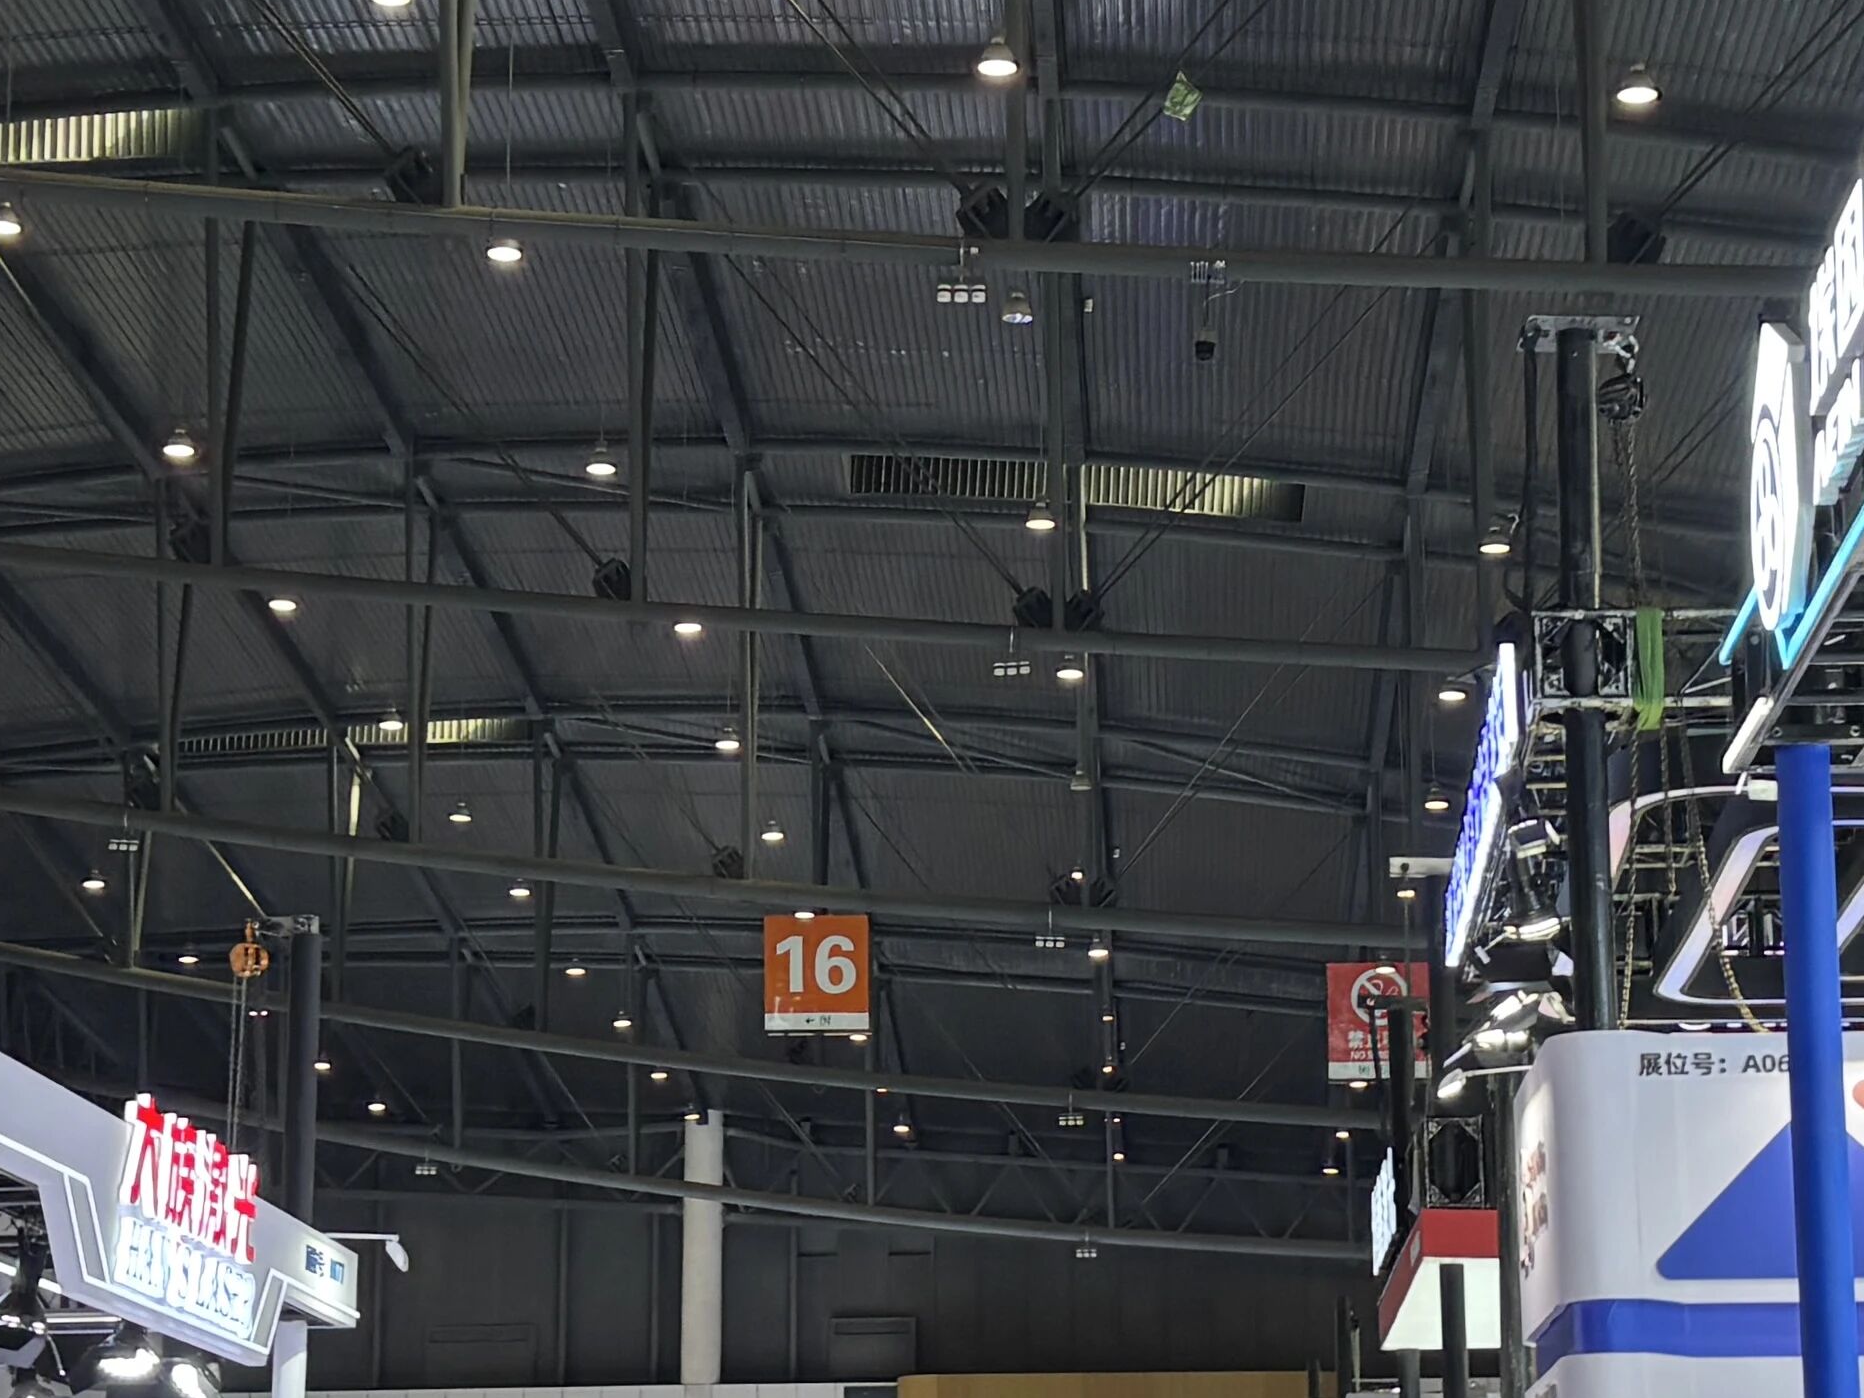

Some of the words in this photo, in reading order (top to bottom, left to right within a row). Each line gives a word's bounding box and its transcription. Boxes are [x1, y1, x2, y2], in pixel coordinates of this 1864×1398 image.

[776, 935, 856, 994] 16
[1638, 1053, 1791, 1077] 展位号：A06
